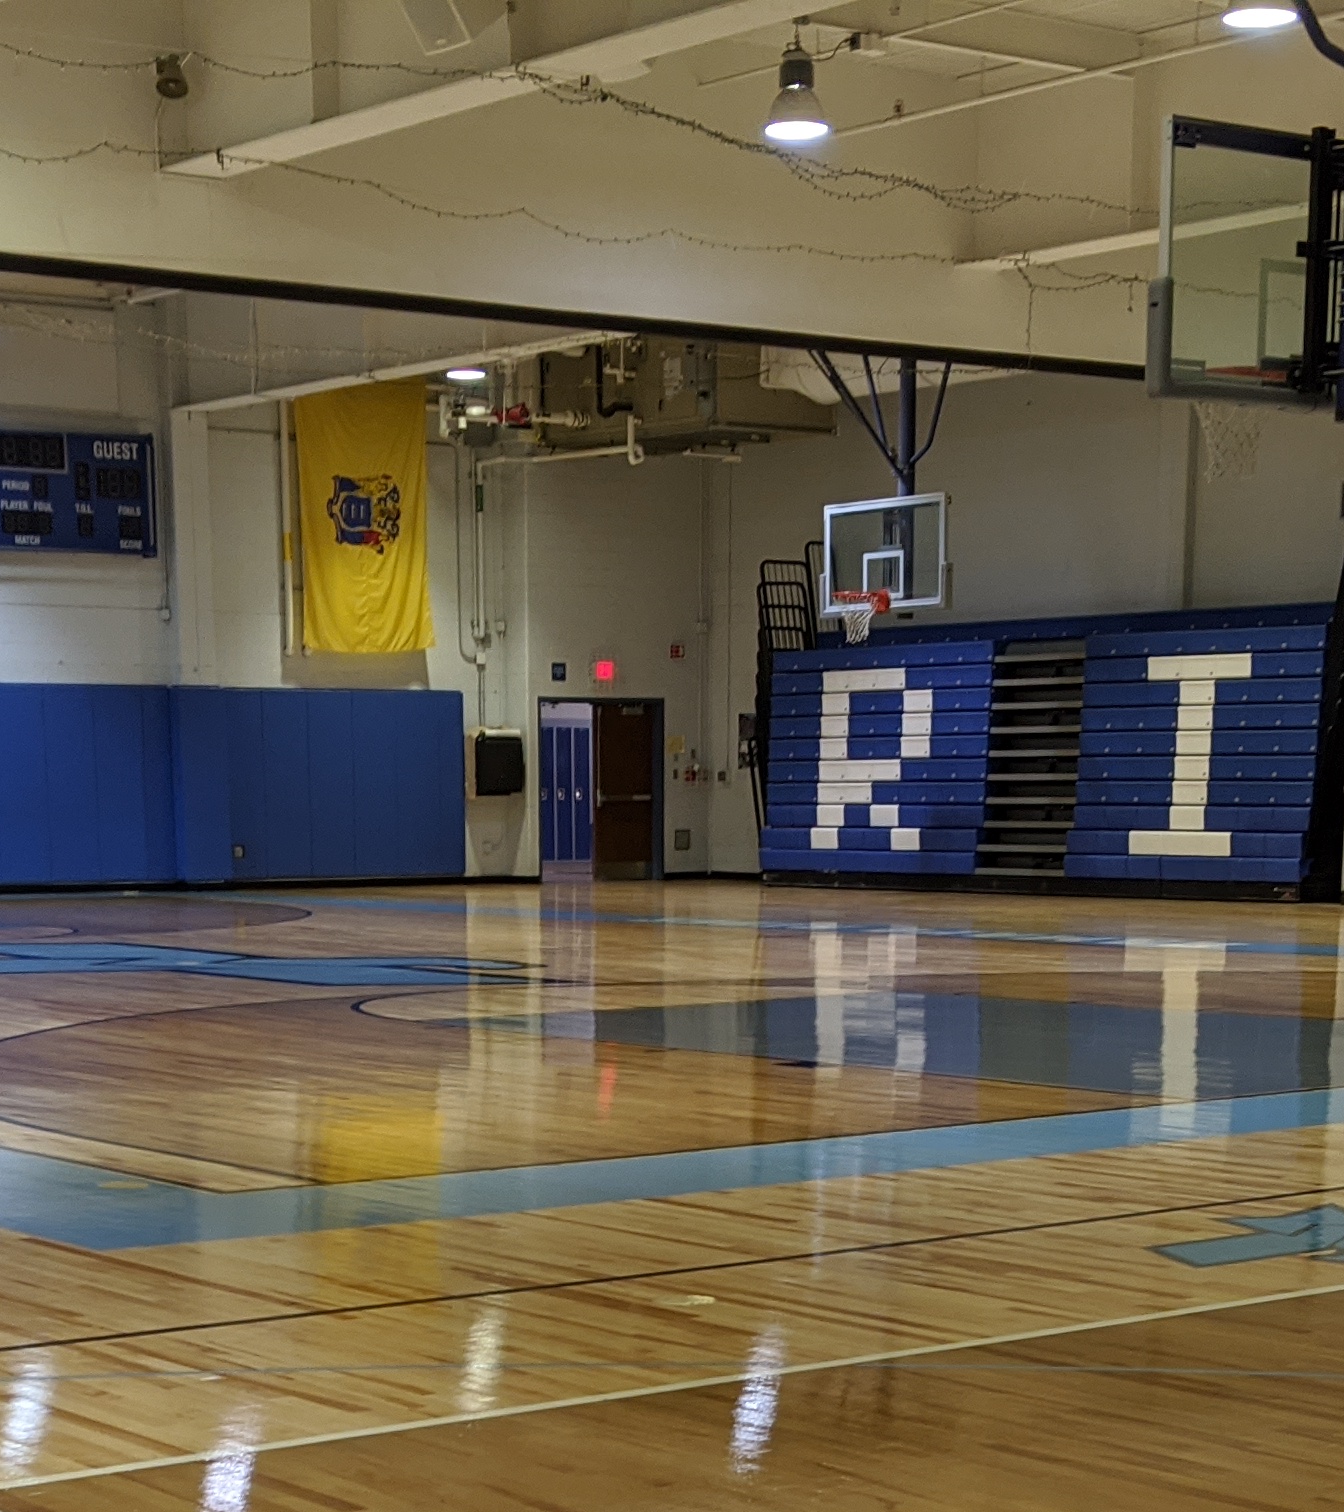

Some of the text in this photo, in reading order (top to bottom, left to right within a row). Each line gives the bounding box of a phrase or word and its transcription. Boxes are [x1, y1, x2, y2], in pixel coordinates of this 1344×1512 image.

[93, 440, 139, 461] GUEST
[0, 500, 29, 511] PLAYER
[14, 534, 41, 545] MATCH
